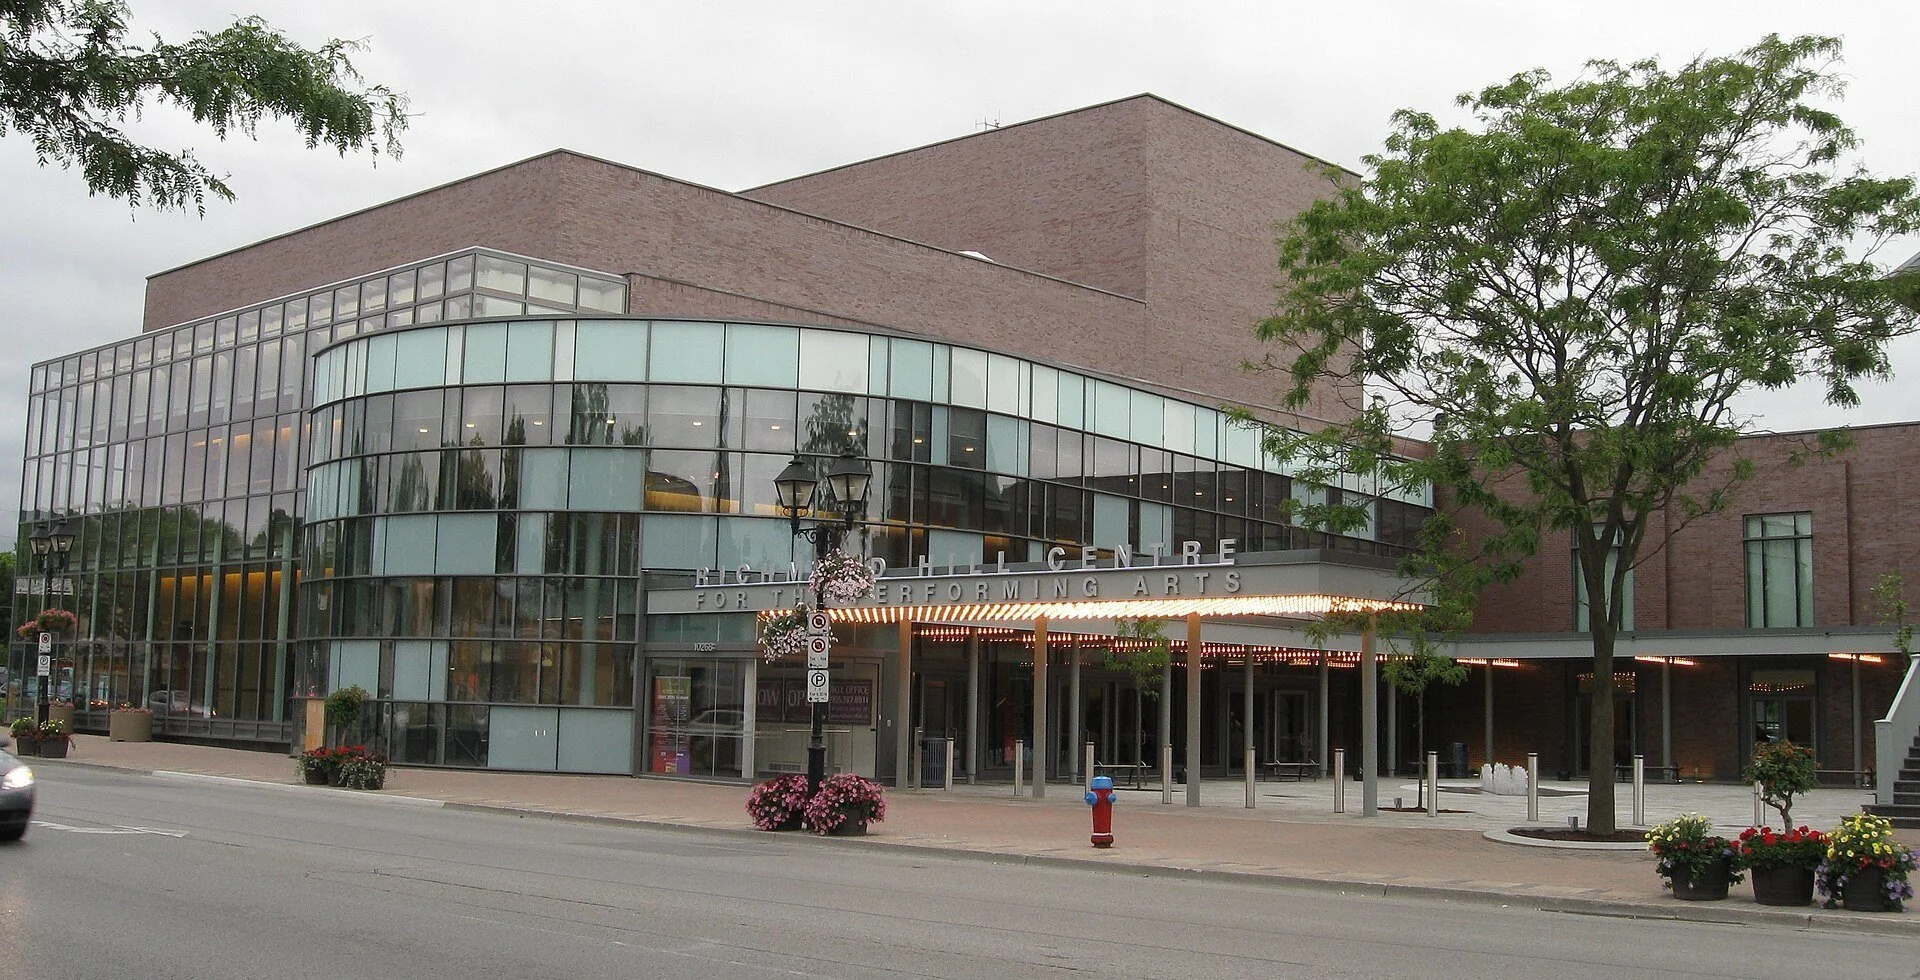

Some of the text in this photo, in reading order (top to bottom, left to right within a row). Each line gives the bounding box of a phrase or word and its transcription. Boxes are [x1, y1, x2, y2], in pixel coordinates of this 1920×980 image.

[696, 538, 1237, 586] RICHMD HILL CENTRE
[697, 591, 748, 610] FOR
[853, 577, 1098, 604] ERFORMING
[1133, 571, 1241, 596] ARTS
[756, 689, 812, 707] OW OP
